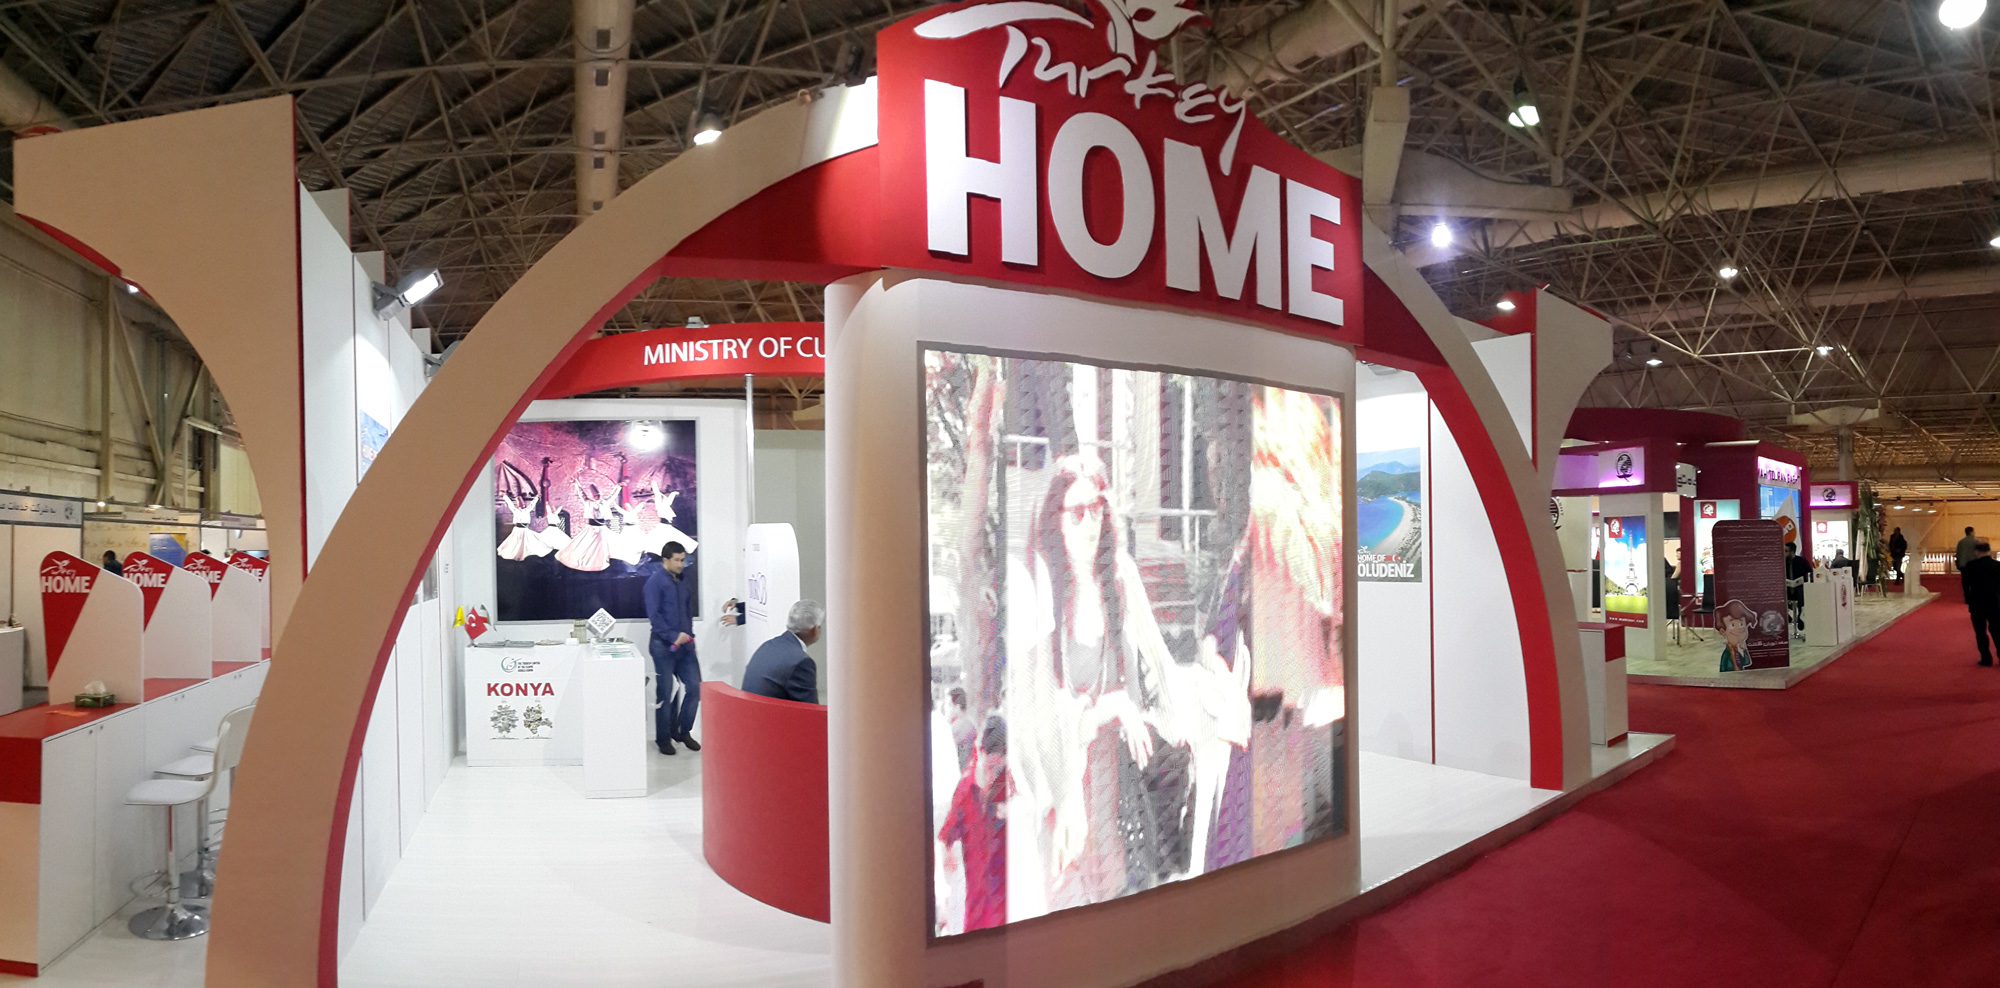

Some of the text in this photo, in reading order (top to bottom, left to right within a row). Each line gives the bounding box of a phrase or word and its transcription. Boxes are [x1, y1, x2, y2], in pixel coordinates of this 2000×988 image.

[924, 78, 1345, 328] HOME
[643, 337, 753, 366] MINISTRY
[758, 336, 793, 358] OF
[1357, 560, 1415, 577] ÖLÜDENİZ
[41, 575, 91, 593] HOME
[487, 682, 555, 696] KONYA
